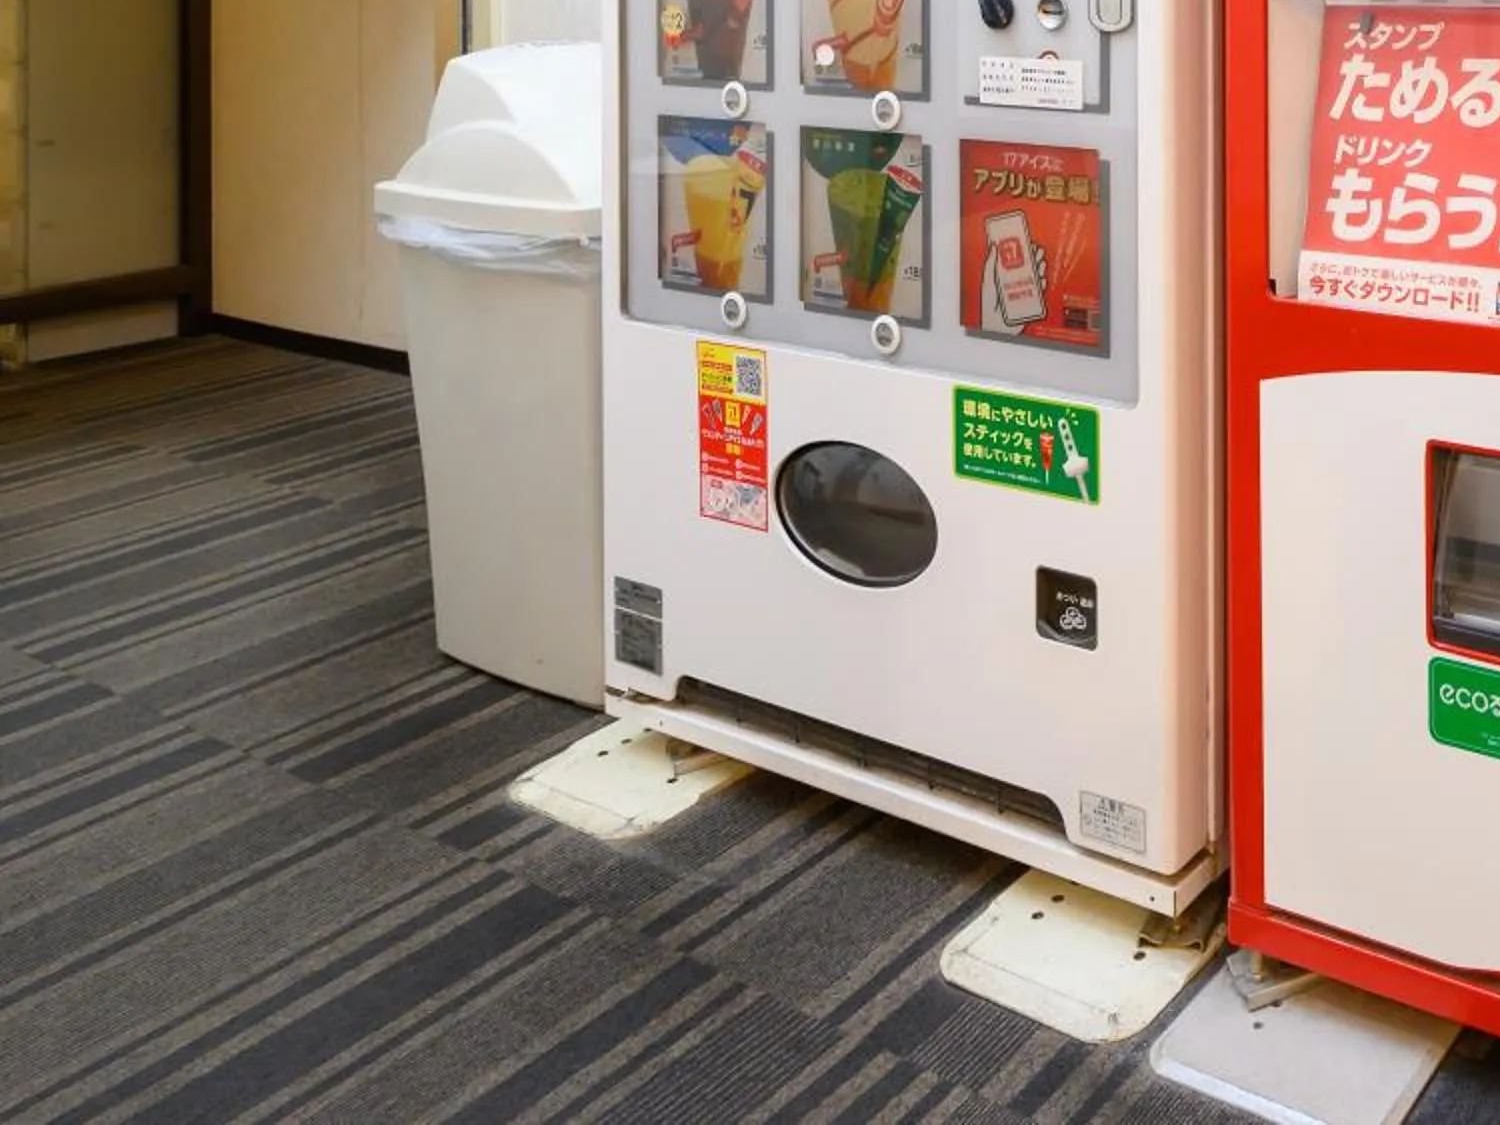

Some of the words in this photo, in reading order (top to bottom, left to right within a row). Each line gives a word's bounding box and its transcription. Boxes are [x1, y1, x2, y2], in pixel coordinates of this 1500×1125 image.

[1344, 20, 1446, 50] スタンプ
[1334, 135, 1434, 167] ドリンク
[962, 398, 1054, 429] 環境にやさしい
[962, 422, 1034, 451] スティックを
